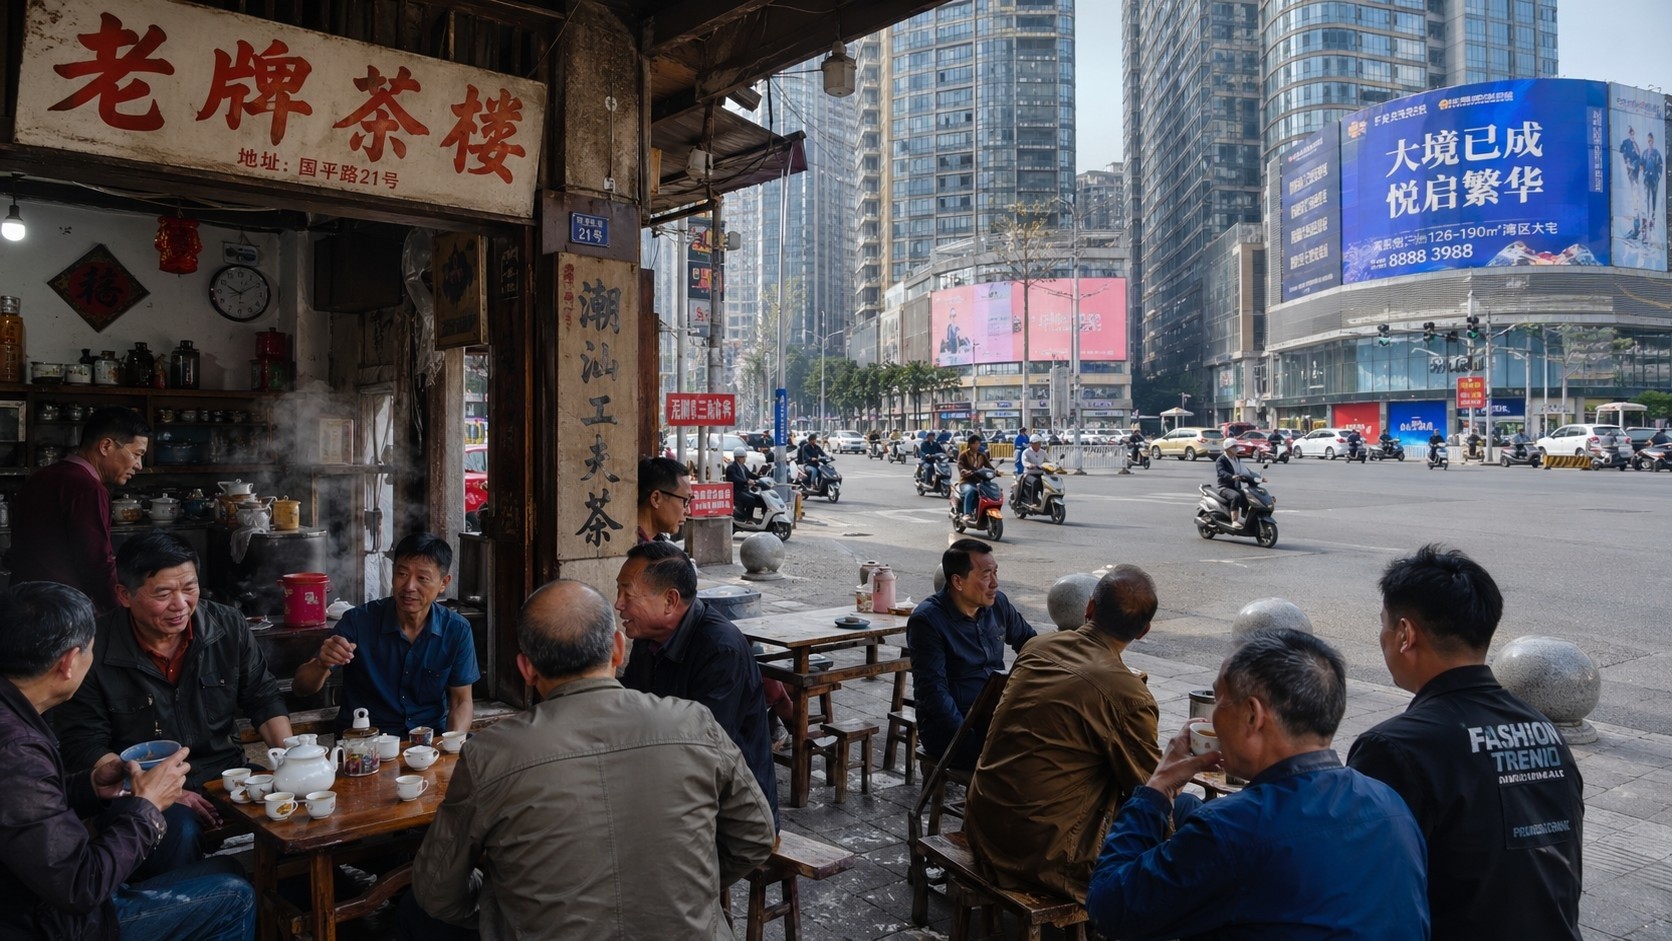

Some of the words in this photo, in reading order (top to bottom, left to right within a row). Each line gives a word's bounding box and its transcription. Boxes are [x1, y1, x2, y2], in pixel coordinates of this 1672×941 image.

[47, 12, 526, 184] 老牌茶楼
[237, 147, 400, 190] 地址：国平路21号
[1386, 120, 1543, 178] 大境已成
[1386, 167, 1544, 219] 悦启繁华
[1388, 249, 1427, 268] 8888
[1431, 243, 1473, 261] 3988
[574, 279, 624, 548] 潮汕工夫茶
[1467, 721, 1563, 753] FASHION
